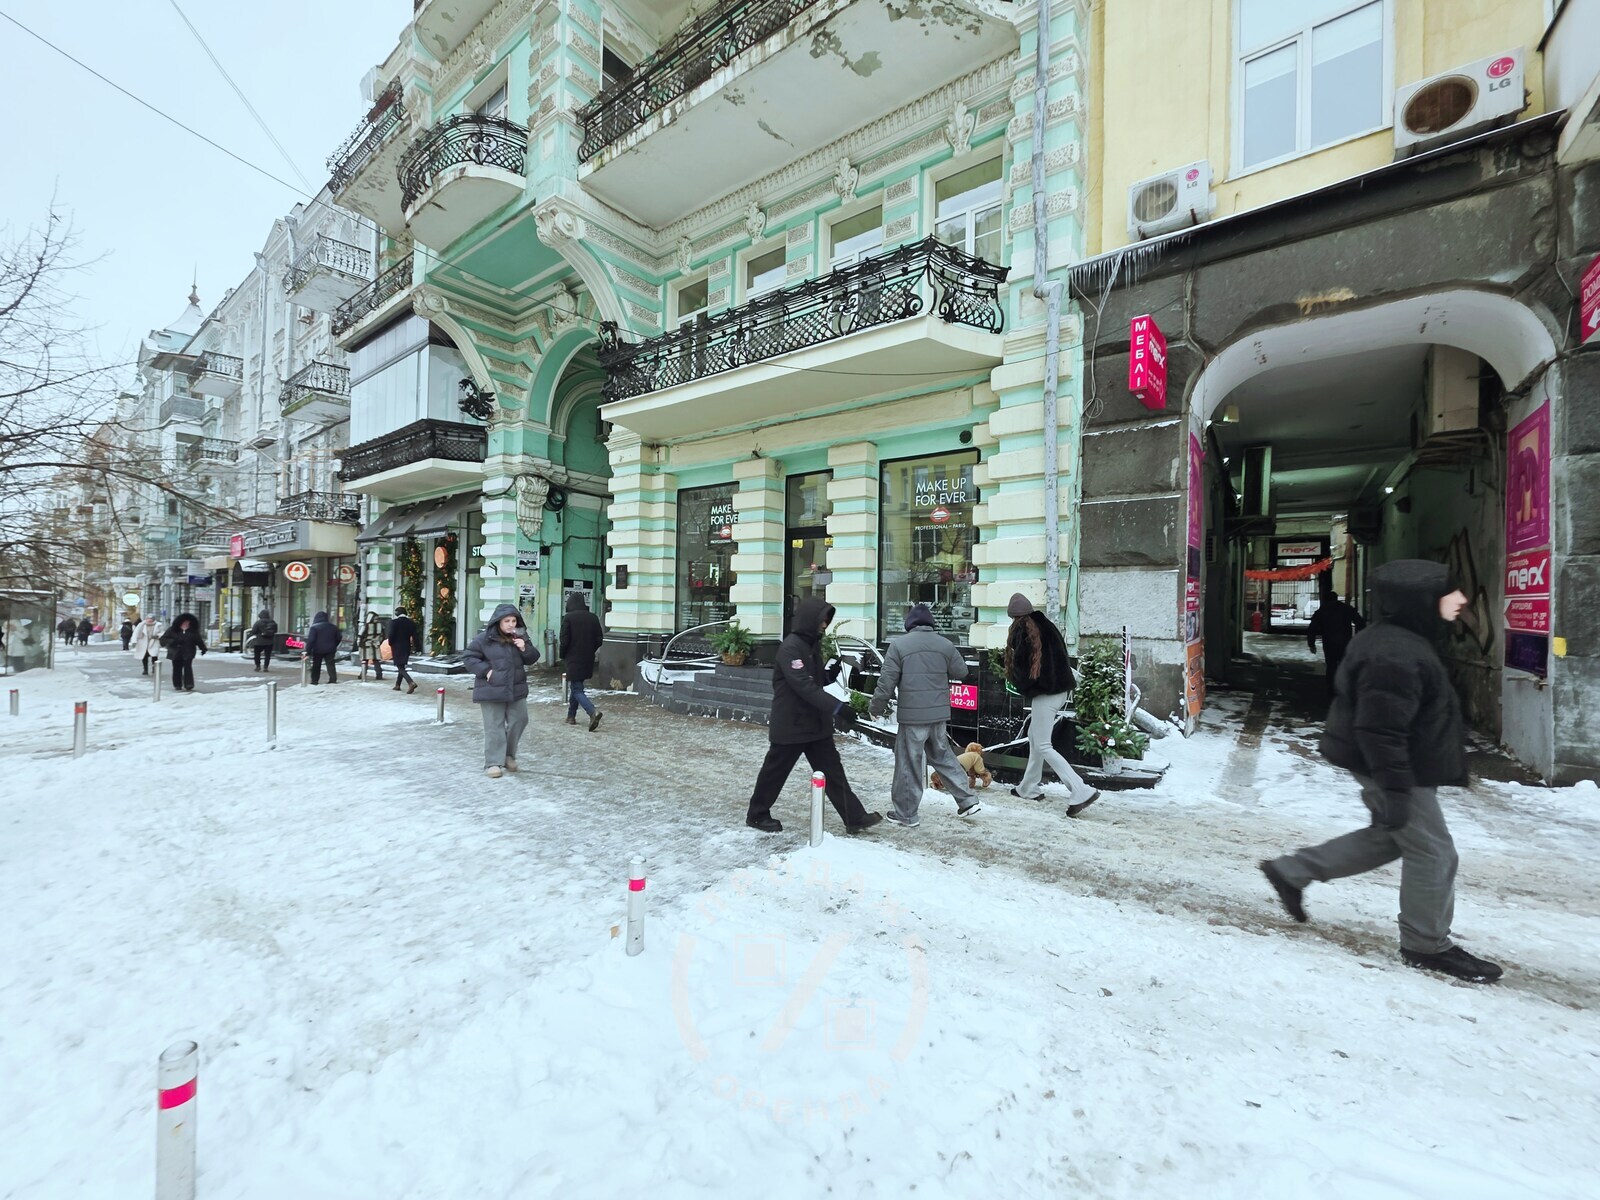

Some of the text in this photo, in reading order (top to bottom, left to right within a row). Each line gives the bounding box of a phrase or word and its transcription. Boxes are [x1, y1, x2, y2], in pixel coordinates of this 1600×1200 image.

[1489, 78, 1512, 92] LG
[1186, 181, 1198, 189] LG
[1134, 320, 1147, 387] МЕБЛІ
[916, 477, 967, 494] MAKE UP
[915, 491, 967, 507] FOR EVER
[711, 504, 732, 515] MAKE
[710, 514, 739, 526] FOR EVE
[1507, 558, 1548, 591] merx
[949, 685, 970, 697] НДА
[950, 698, 975, 707] -02-20
